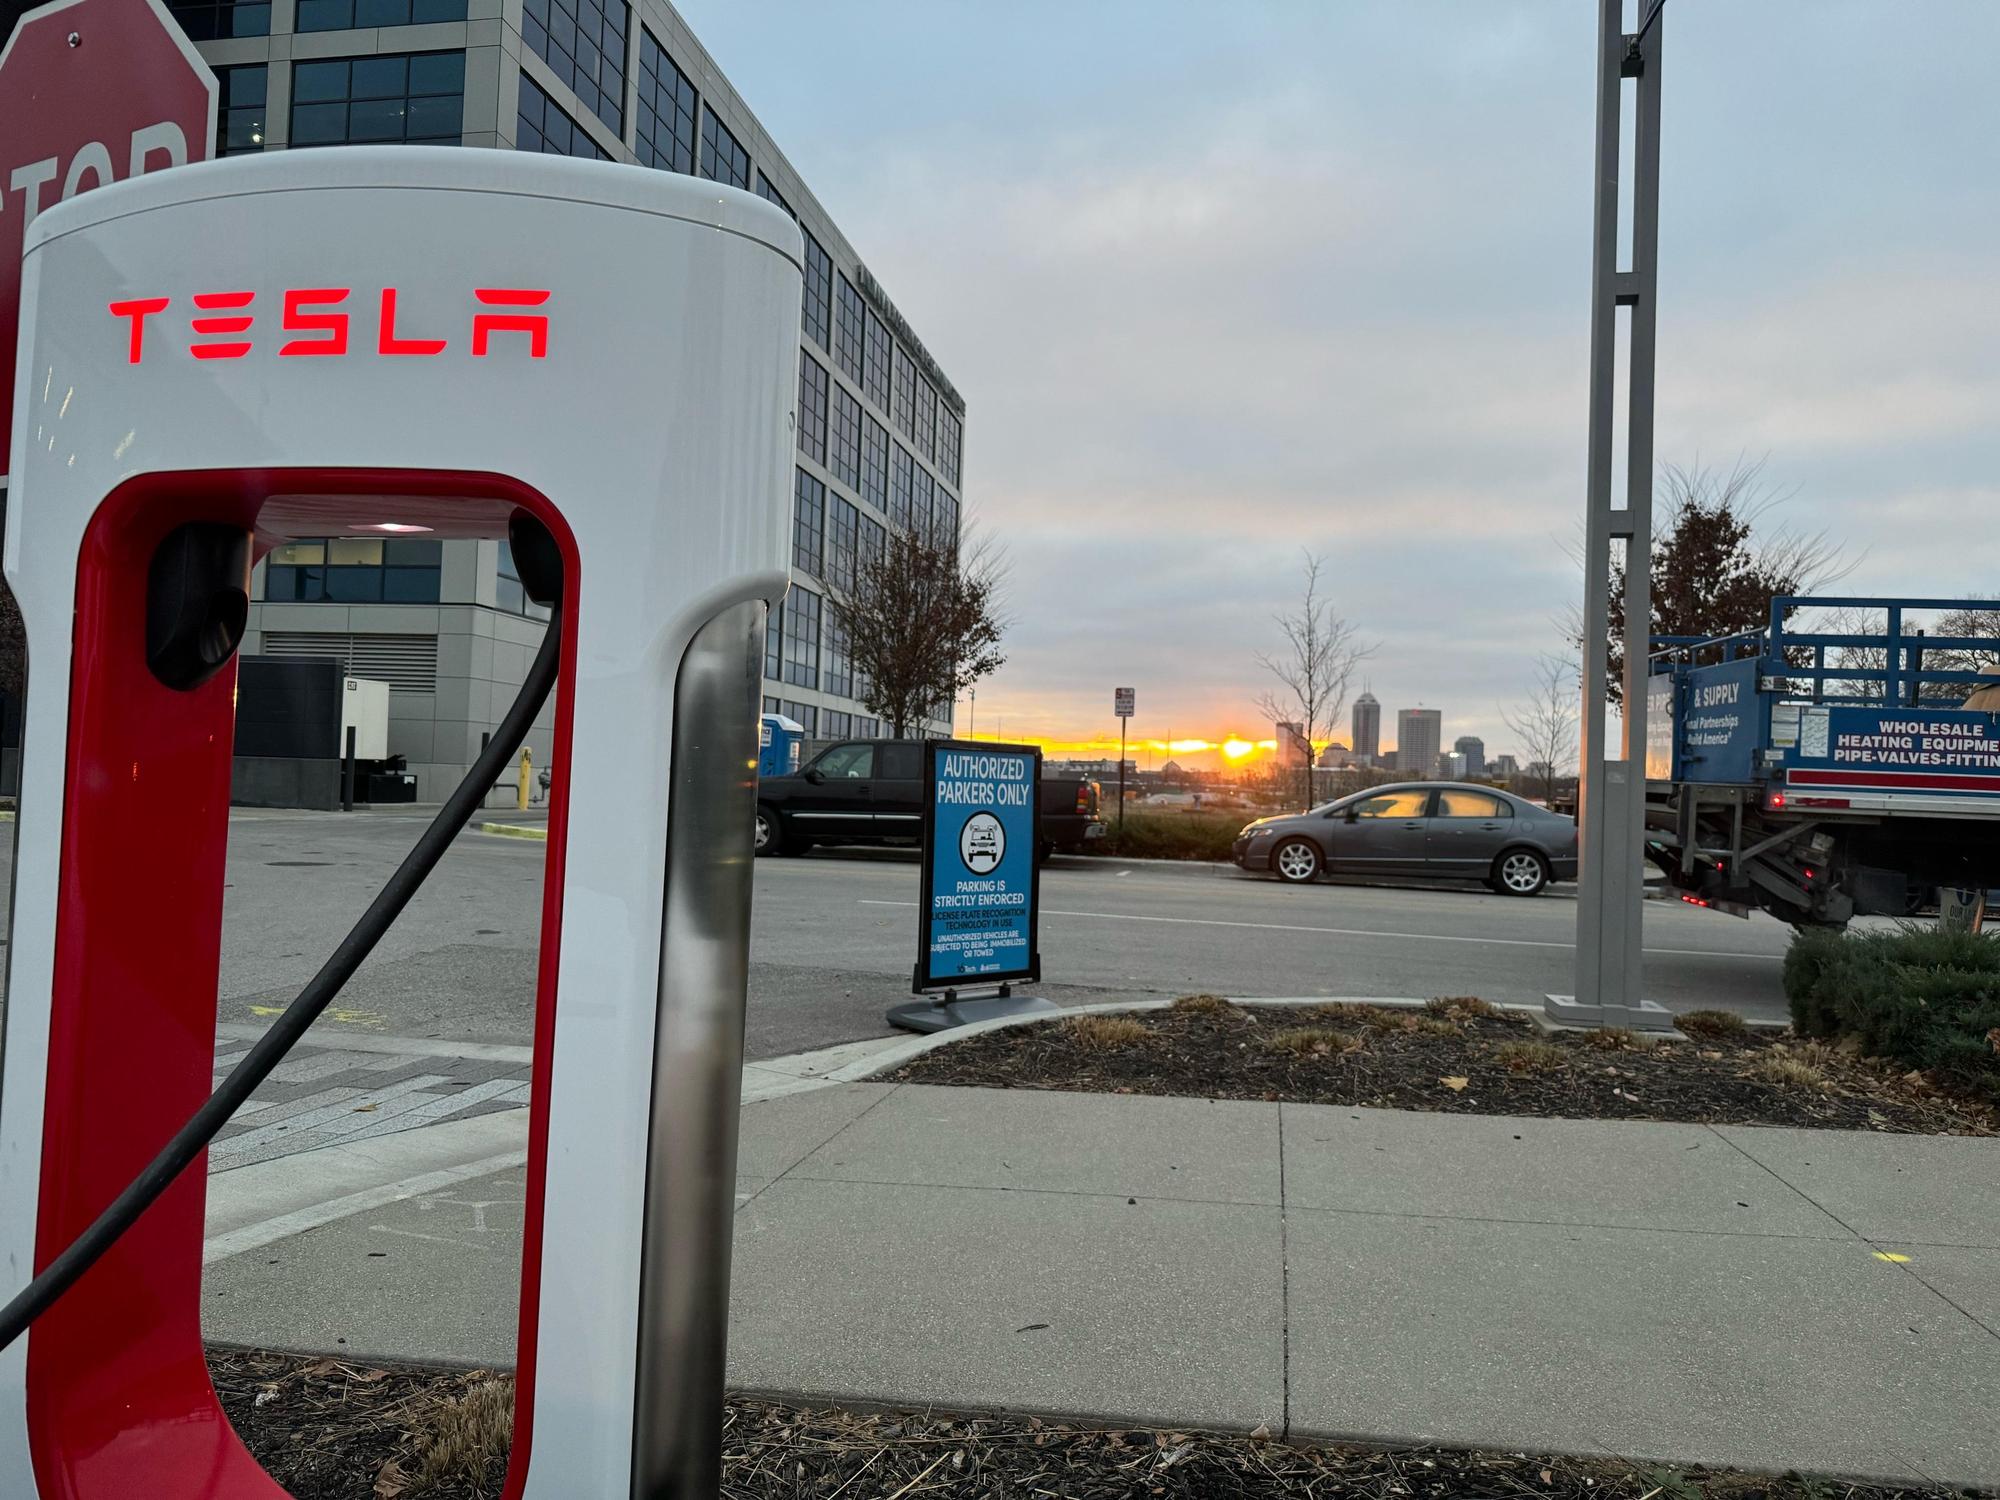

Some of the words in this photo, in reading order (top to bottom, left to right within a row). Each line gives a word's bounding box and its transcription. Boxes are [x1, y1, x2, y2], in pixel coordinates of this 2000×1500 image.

[109, 288, 551, 363] TESLA
[1694, 689, 1701, 708] &
[1703, 683, 1739, 706] SUPPLY
[1700, 714, 1738, 730] Partnerships
[1879, 721, 1983, 737] WHOLESALE
[1838, 735, 1912, 749] HEATING
[1922, 738, 2000, 752] EQUIPME
[944, 754, 1025, 780] AUTHORIZED
[938, 781, 994, 804] PARKERS
[997, 783, 1030, 805] ONLY
[956, 881, 995, 892] PARKING
[997, 880, 1006, 891] IS
[935, 894, 976, 907] STRICTLY
[978, 893, 1024, 905] ENFORCED
[932, 910, 960, 920] LICENSE
[961, 909, 980, 919] PLATE
[982, 908, 1026, 918] RECOGNITION
[946, 920, 992, 930] TECHNOLOGY
[992, 919, 999, 927] IN
[1001, 919, 1012, 927] USE
[938, 932, 981, 942] UNAUTHORIZED
[983, 931, 1008, 940] VEHICLES
[1008, 930, 1019, 938] ARE
[971, 940, 988, 949] BEING
[990, 938, 1026, 947] IMMOBILIZED
[964, 950, 972, 958] OR
[973, 948, 994, 957] TOWED
